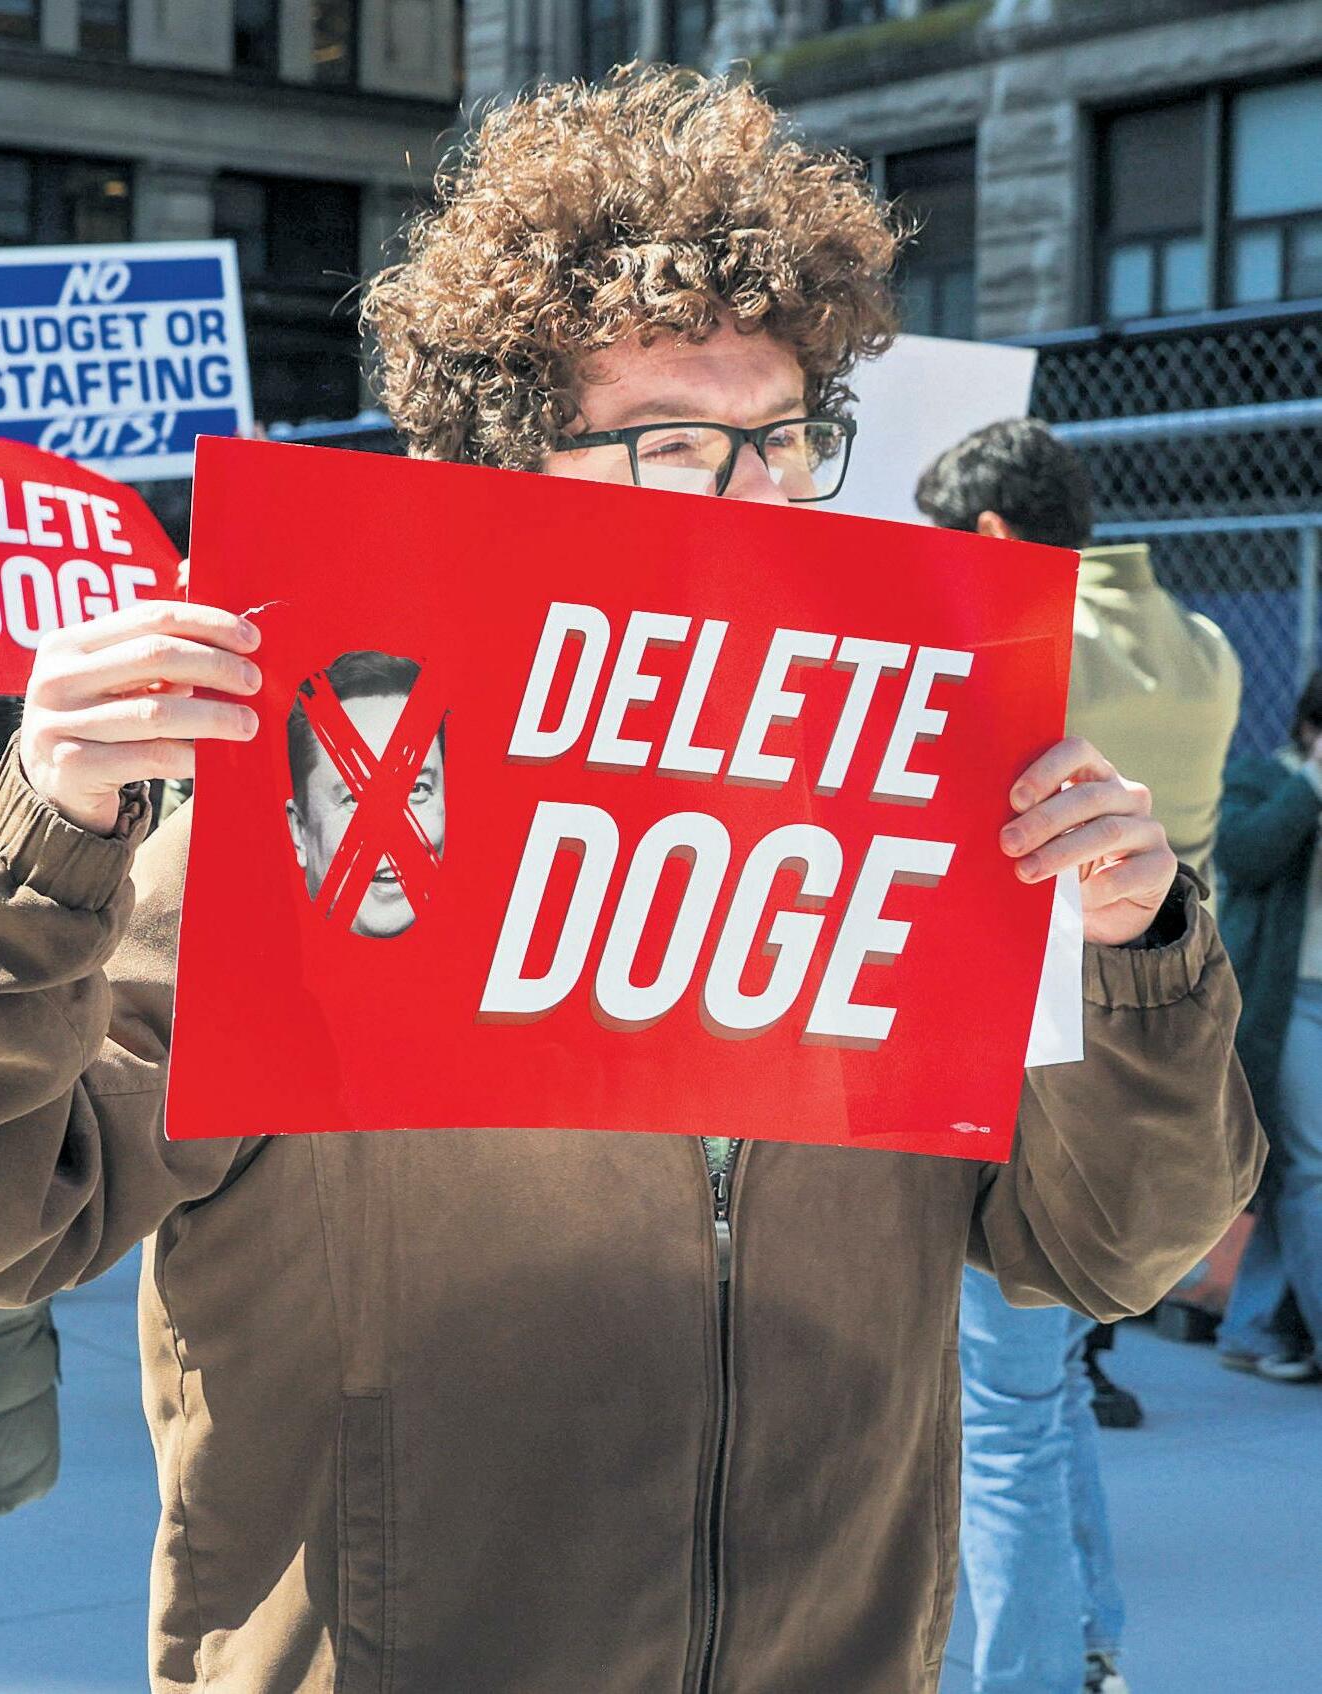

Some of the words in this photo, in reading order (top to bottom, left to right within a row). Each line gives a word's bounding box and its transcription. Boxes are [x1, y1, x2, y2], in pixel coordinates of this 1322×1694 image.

[58, 261, 131, 306] NO
[165, 308, 228, 349] OR
[37, 415, 176, 457] CUTS!
[505, 601, 976, 804] DELETE
[477, 800, 957, 1045] DOGE
